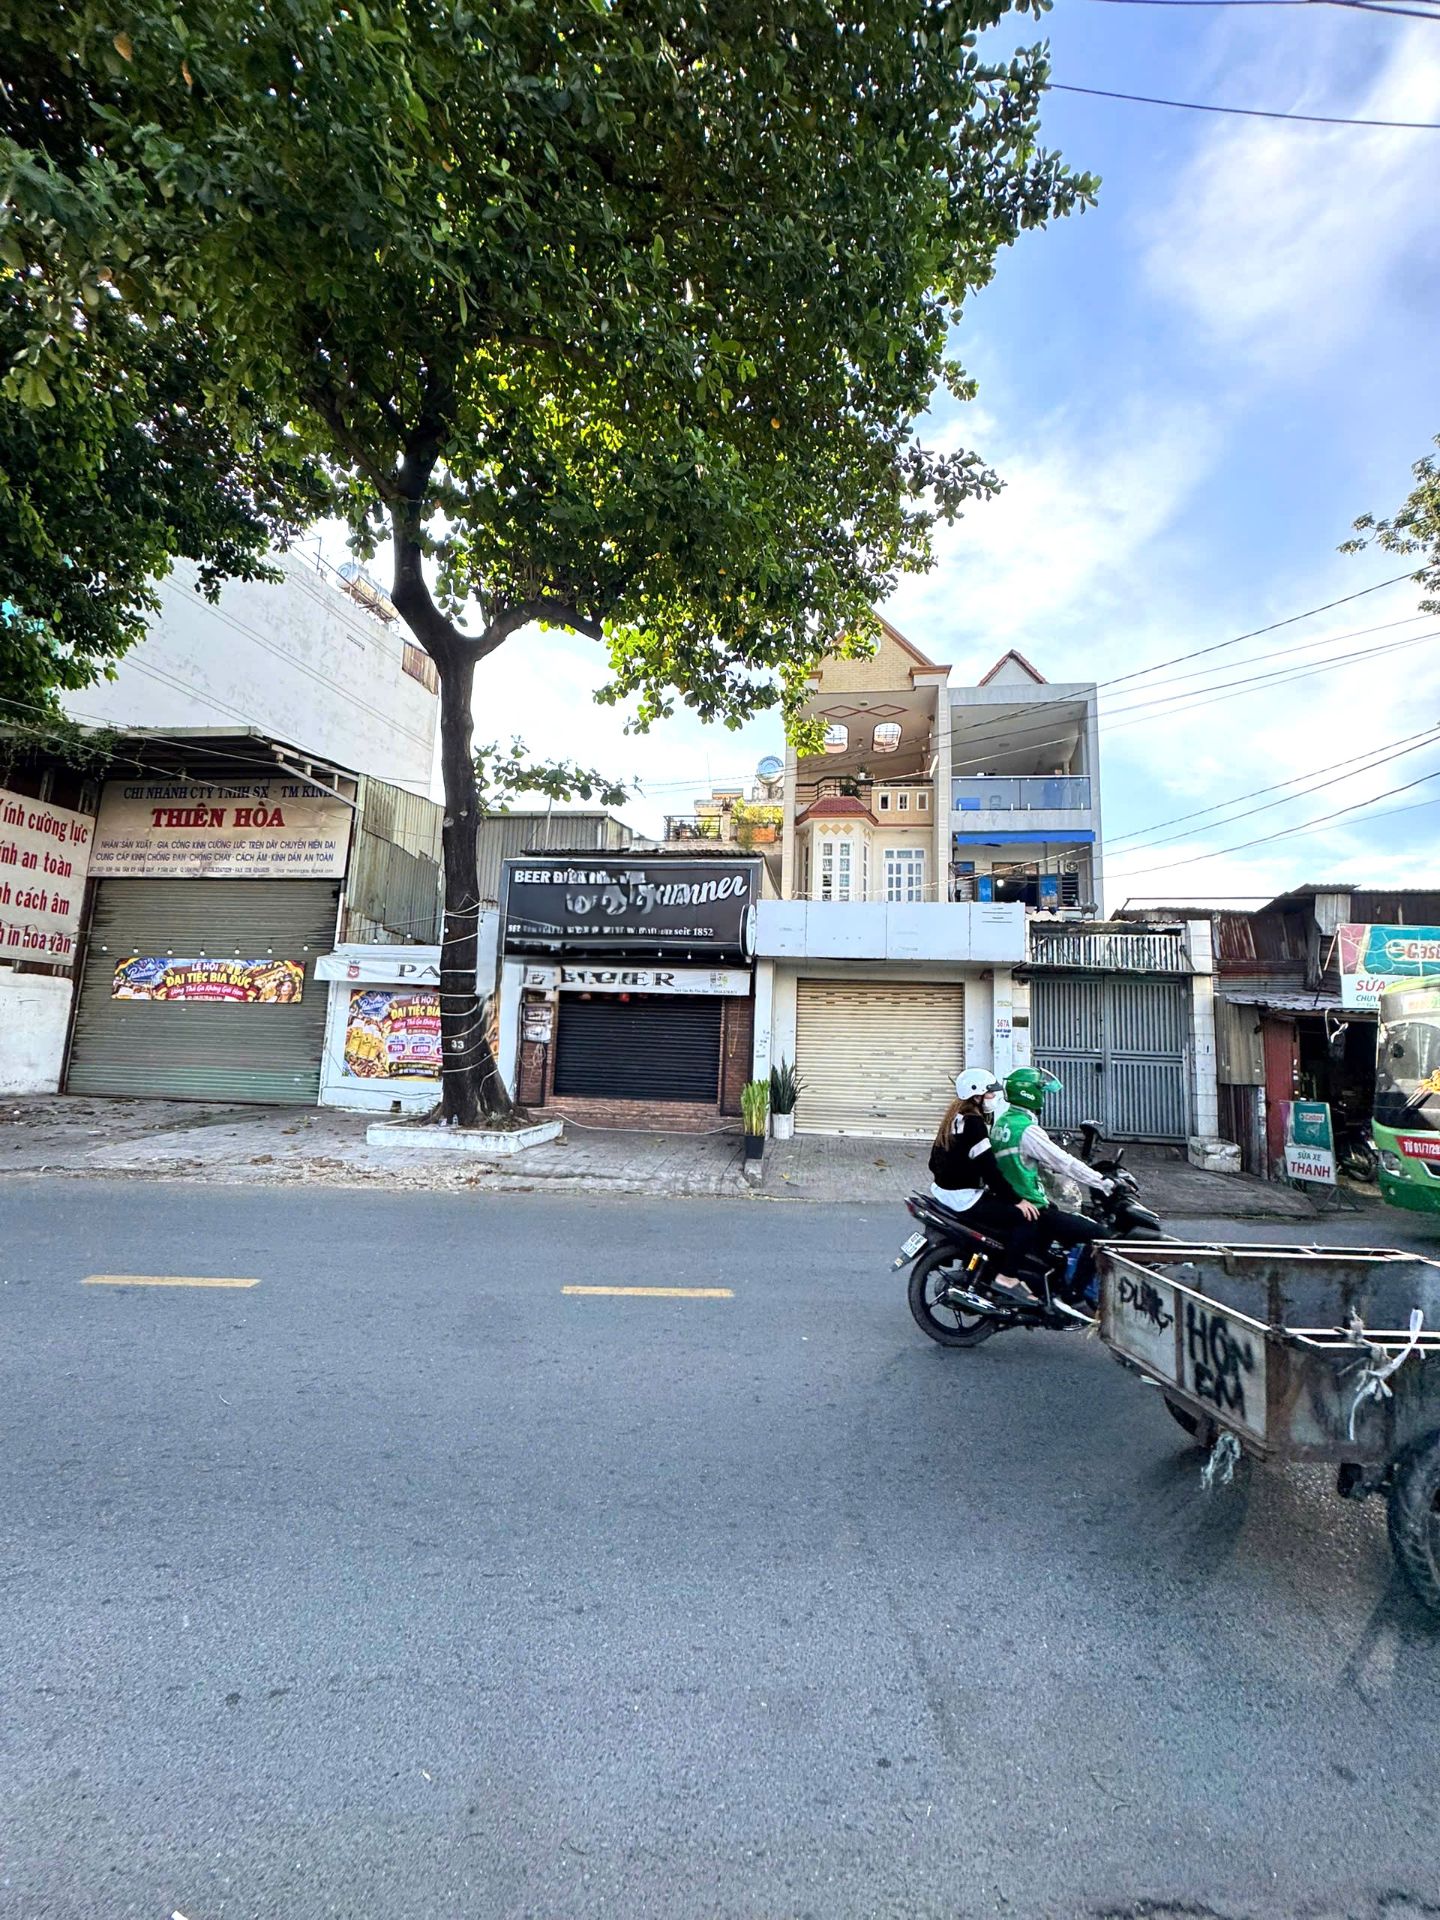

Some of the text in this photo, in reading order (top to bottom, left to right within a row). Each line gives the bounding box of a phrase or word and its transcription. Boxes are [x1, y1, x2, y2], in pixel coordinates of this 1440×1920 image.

[124, 786, 144, 799] CHI
[190, 786, 213, 799] CTY
[253, 785, 269, 799] SX
[281, 785, 299, 798] TM
[151, 800, 285, 828] THIÊN HÒA
[28, 811, 68, 843] cường
[70, 819, 89, 847] lực
[21, 851, 38, 870] an
[44, 851, 72, 878] toàn
[514, 870, 551, 883] BEER
[16, 886, 48, 912] cách
[51, 891, 70, 916] âm
[7, 923, 20, 948] in
[22, 925, 47, 950] hoa
[674, 926, 691, 936] seit
[693, 927, 714, 937] 1852
[187, 970, 208, 984] TIỆC
[210, 972, 227, 984] BIA
[451, 1040, 465, 1050] 33
[1020, 1090, 1036, 1101] Grab
[1312, 1153, 1322, 1162] XE
[1291, 1161, 1331, 1178] THANH
